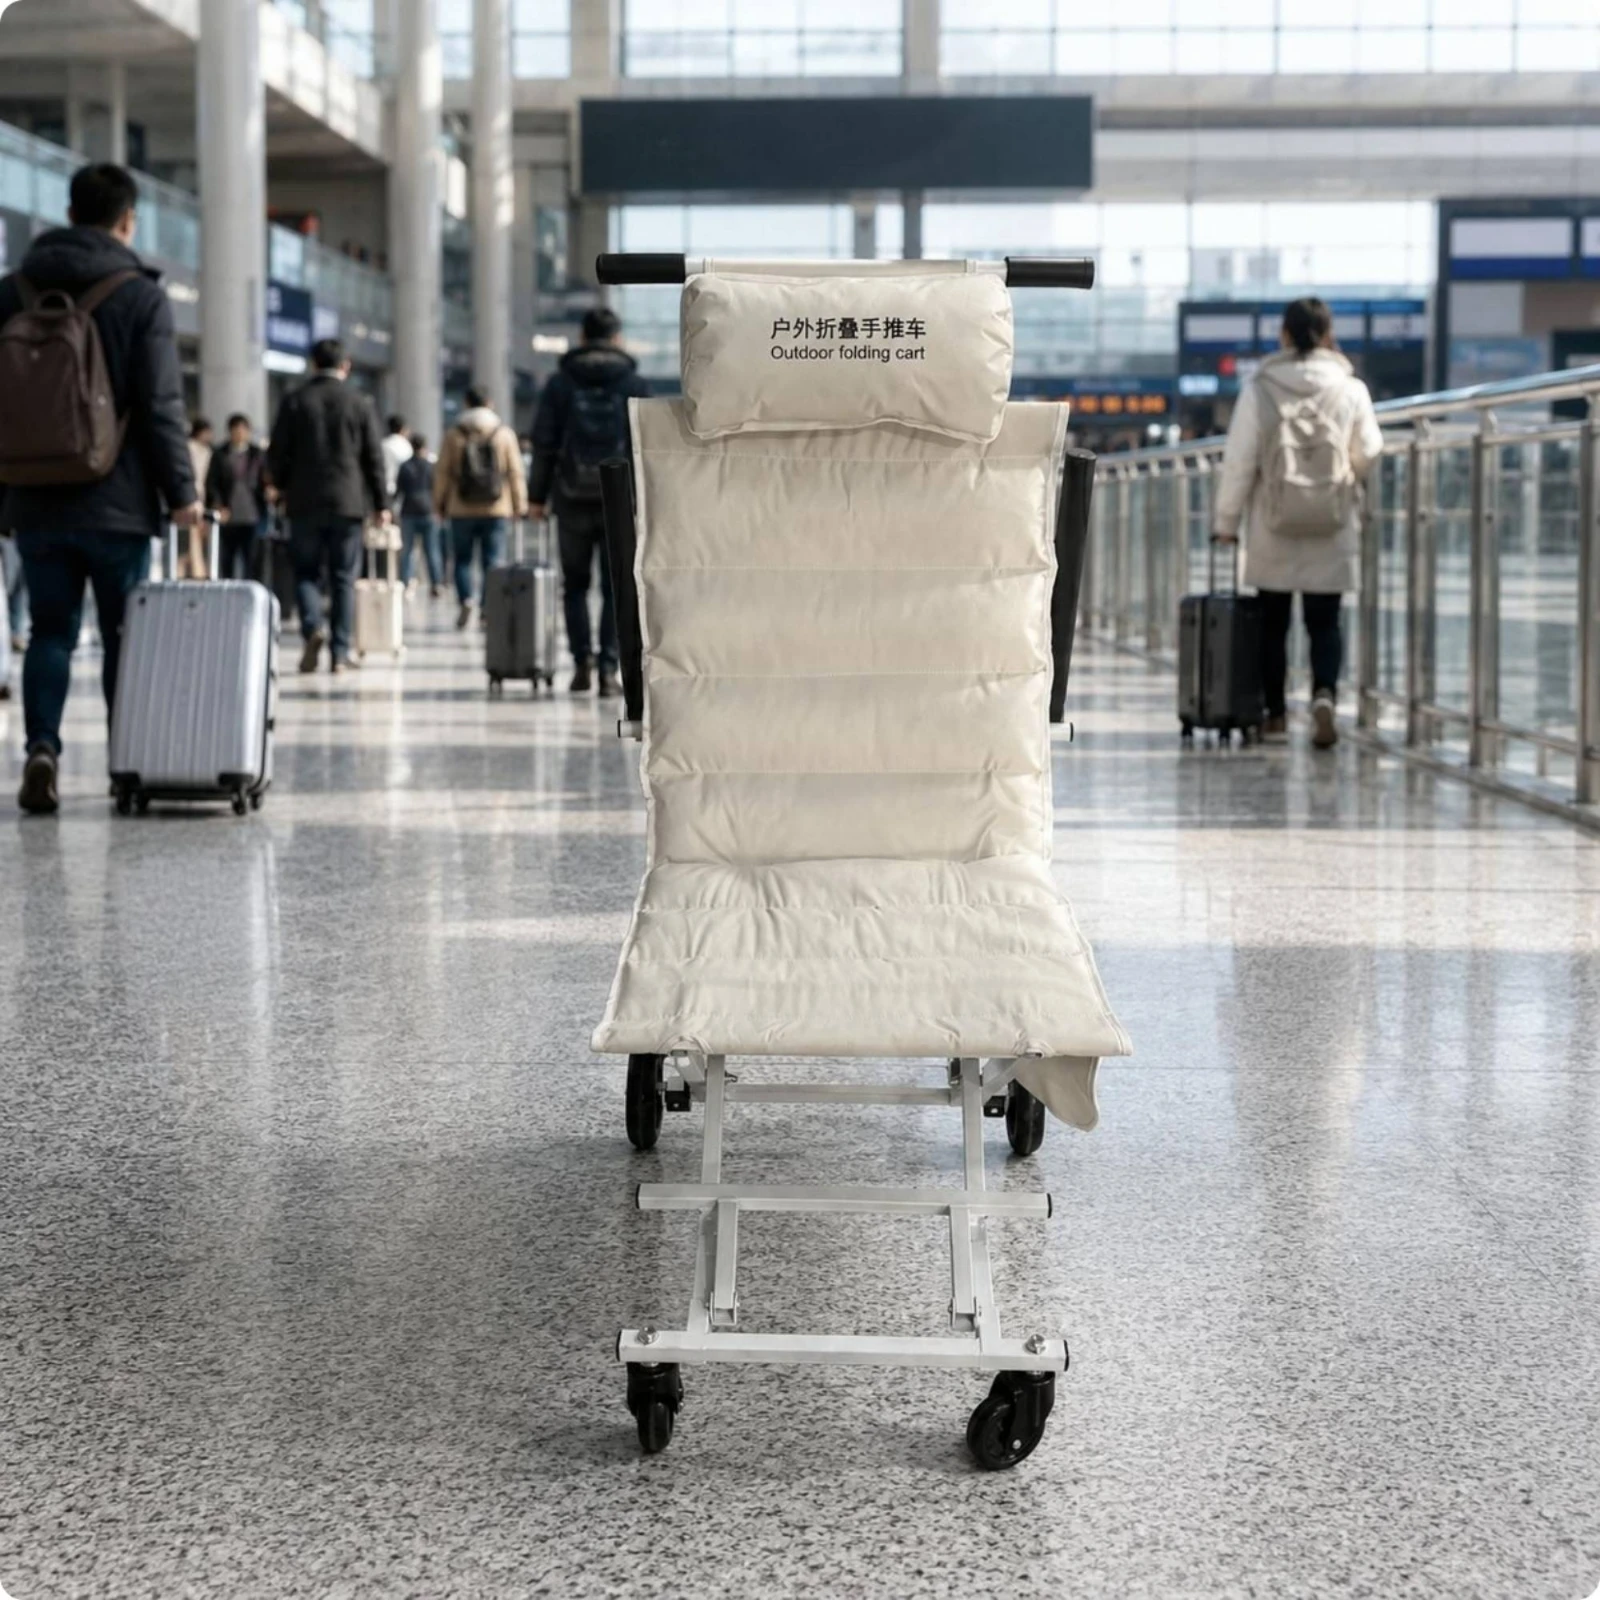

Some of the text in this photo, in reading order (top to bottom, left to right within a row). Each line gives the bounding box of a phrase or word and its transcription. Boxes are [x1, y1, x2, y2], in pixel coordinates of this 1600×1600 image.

[770, 316, 927, 340] 户外折叠手推车
[770, 345, 925, 363] Outdoor folding cart
